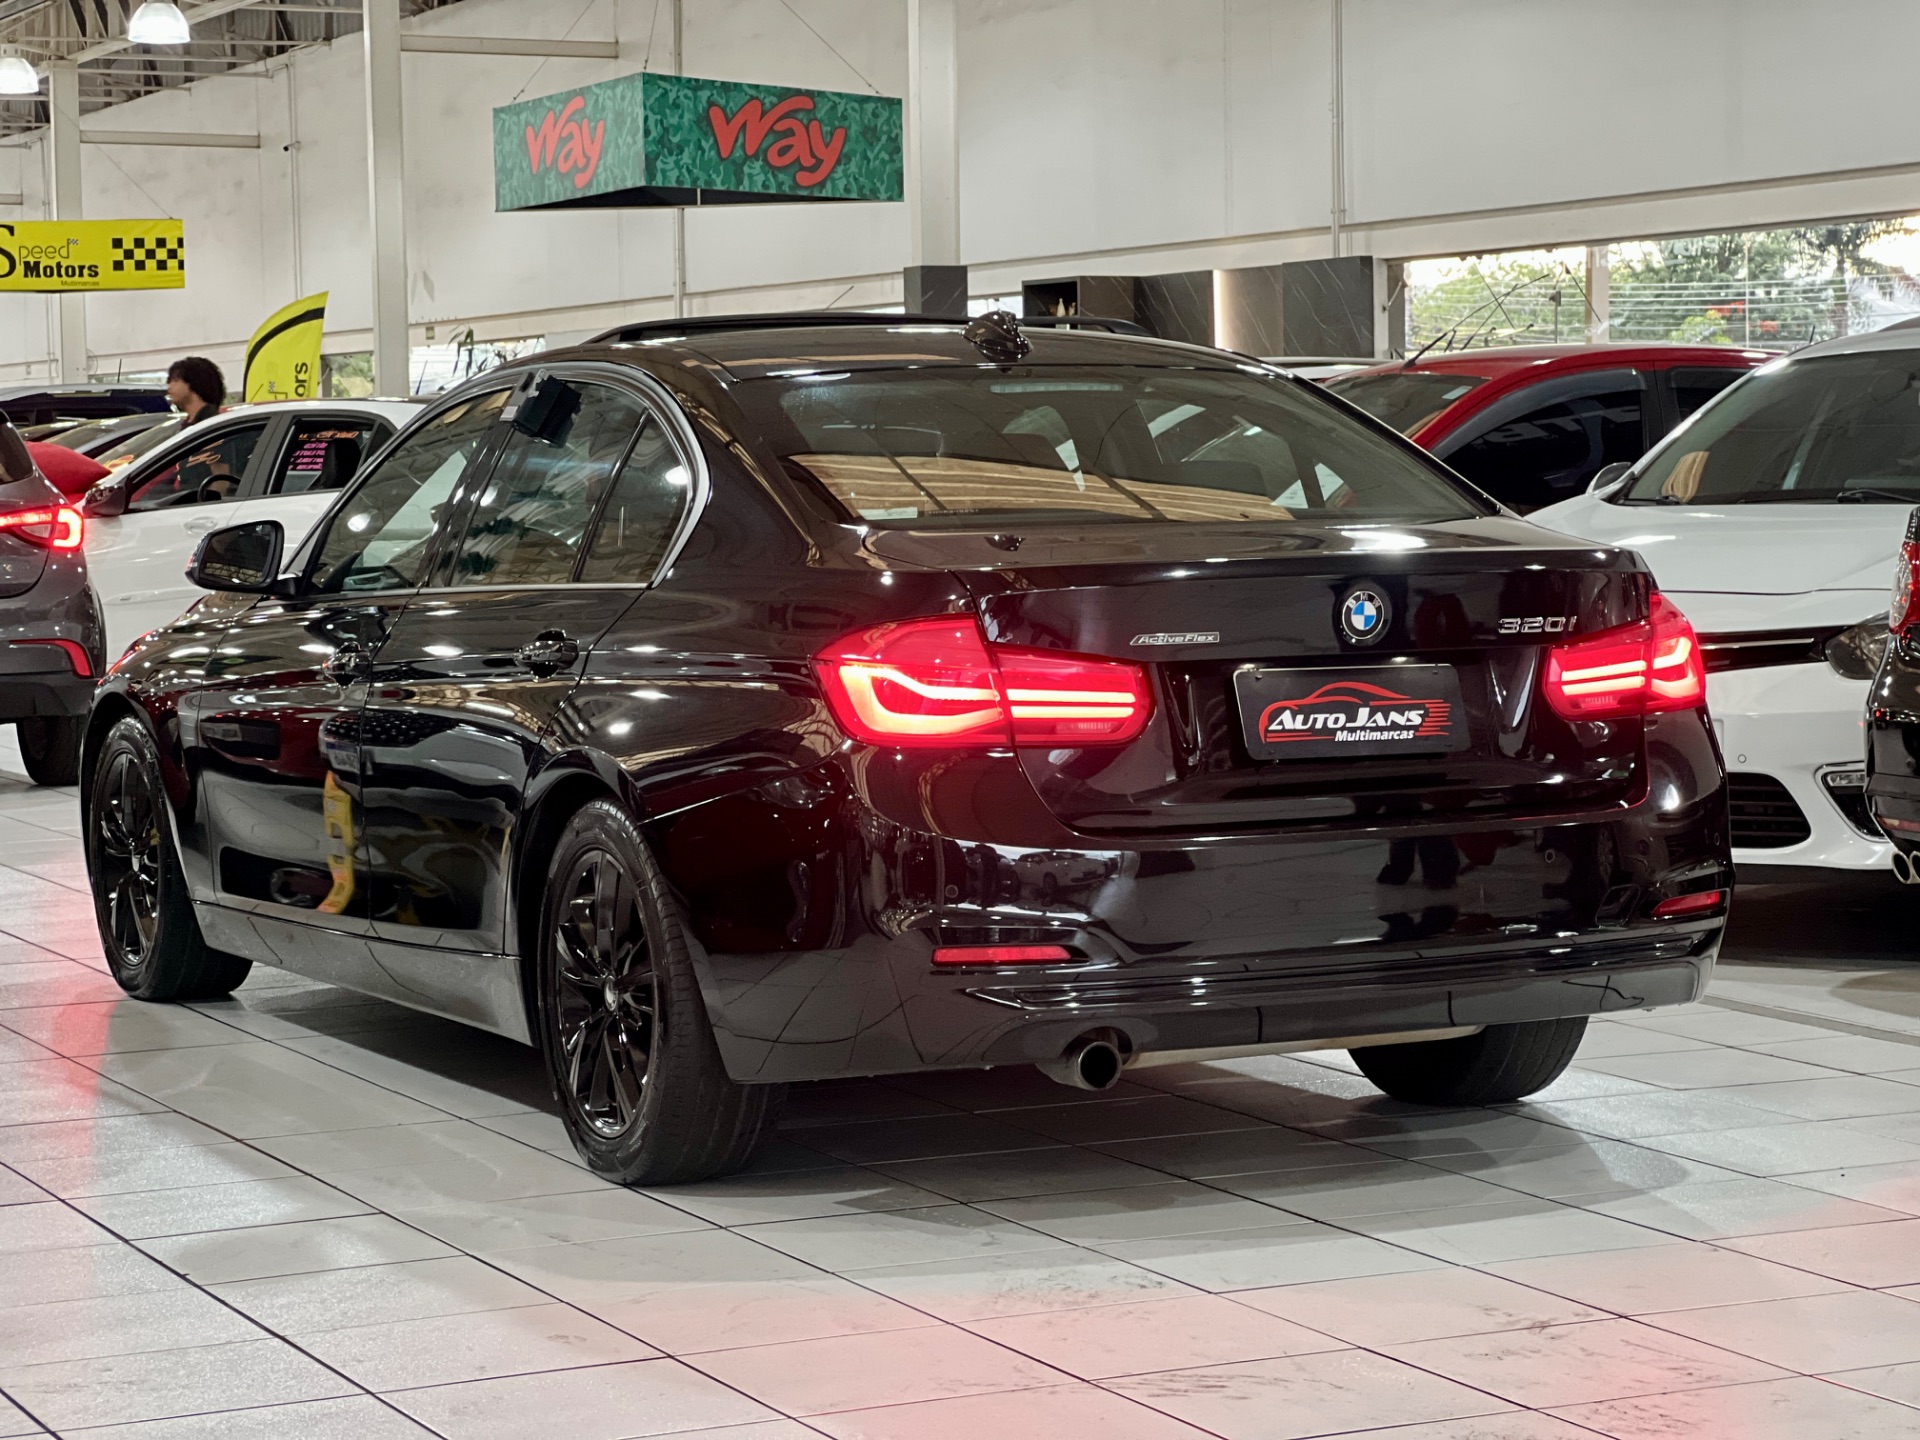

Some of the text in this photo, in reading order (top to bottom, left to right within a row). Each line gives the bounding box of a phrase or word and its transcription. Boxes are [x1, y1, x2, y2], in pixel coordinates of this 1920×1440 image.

[525, 96, 605, 189] Way
[708, 96, 847, 187] Way
[23, 261, 99, 278] Motors
[1498, 616, 1577, 633] 320i
[1138, 633, 1215, 644] ActiveFlex
[1334, 729, 1414, 742] Multimarcas
